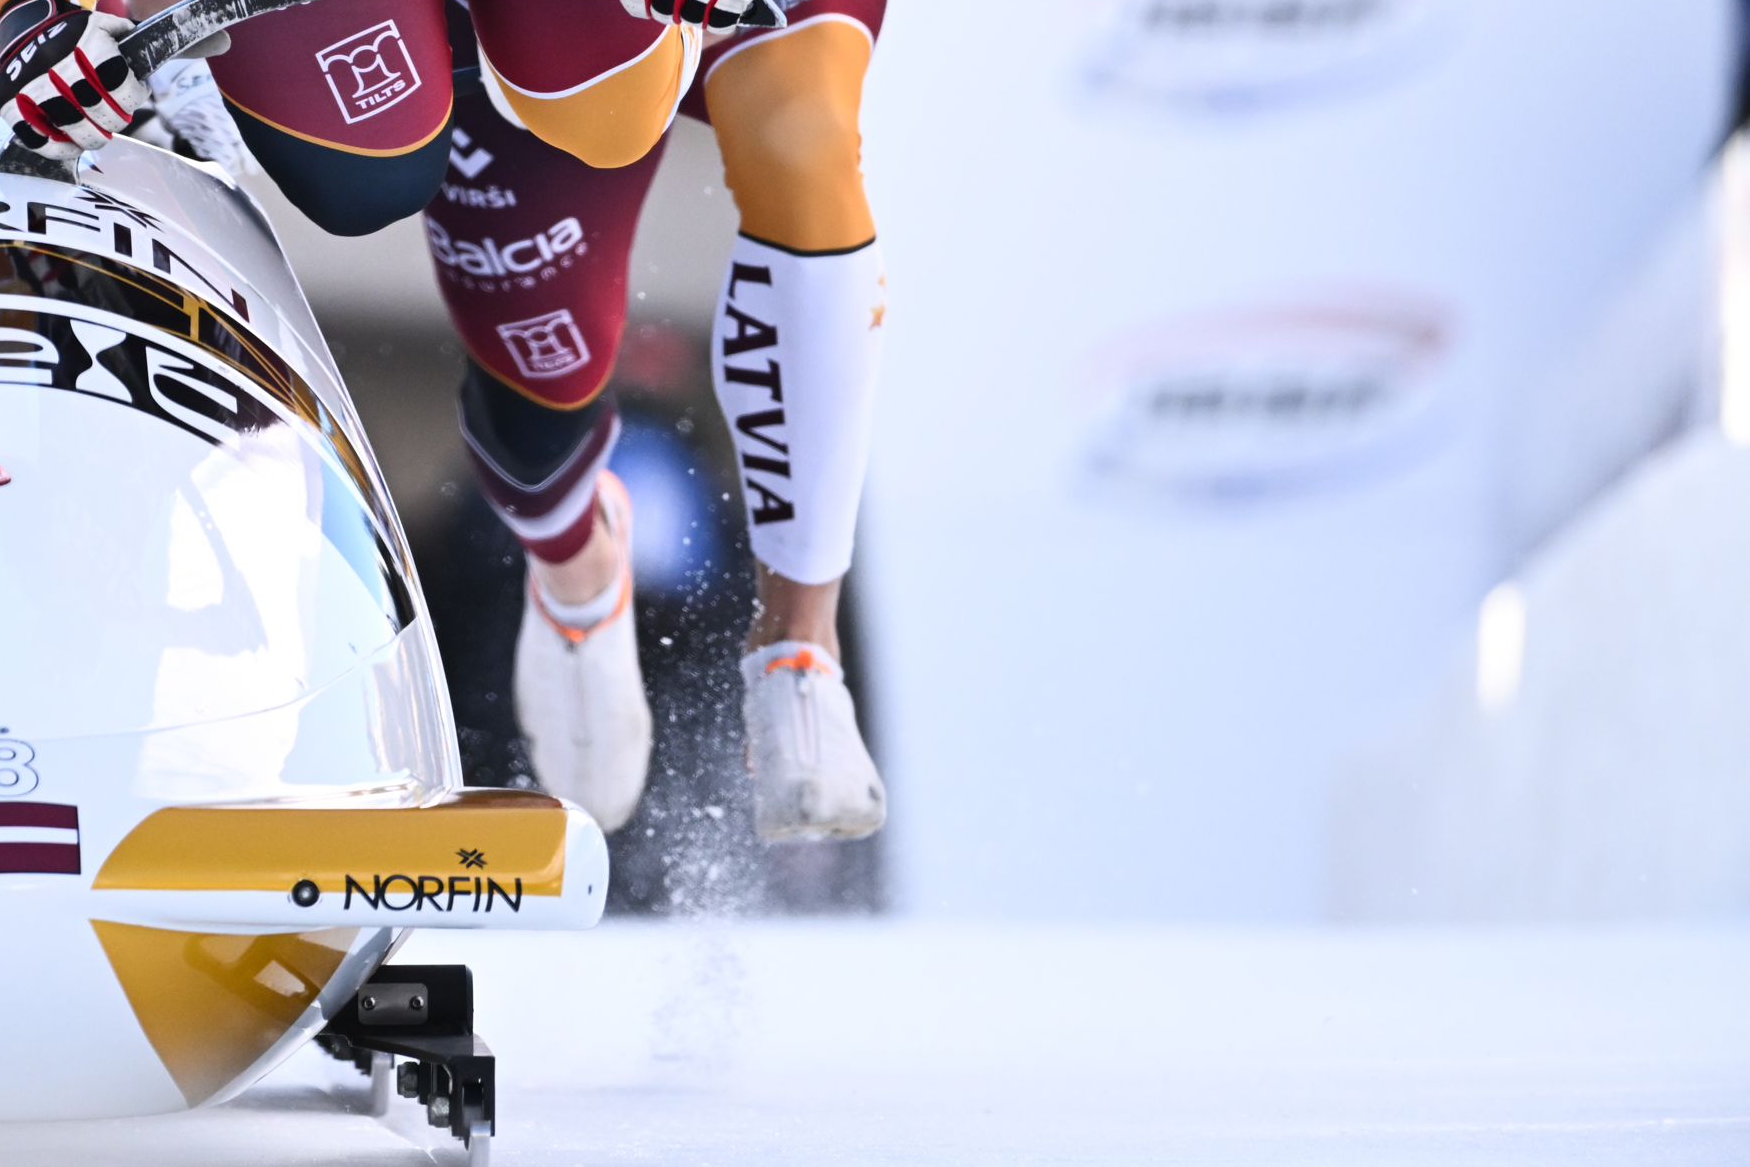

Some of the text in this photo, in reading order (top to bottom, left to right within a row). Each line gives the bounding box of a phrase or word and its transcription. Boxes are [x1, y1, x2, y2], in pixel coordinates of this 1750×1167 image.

[354, 78, 407, 111] TILTS
[425, 216, 584, 277] Balcia
[720, 260, 796, 526] LATVIA
[343, 873, 524, 913] NORFIN
